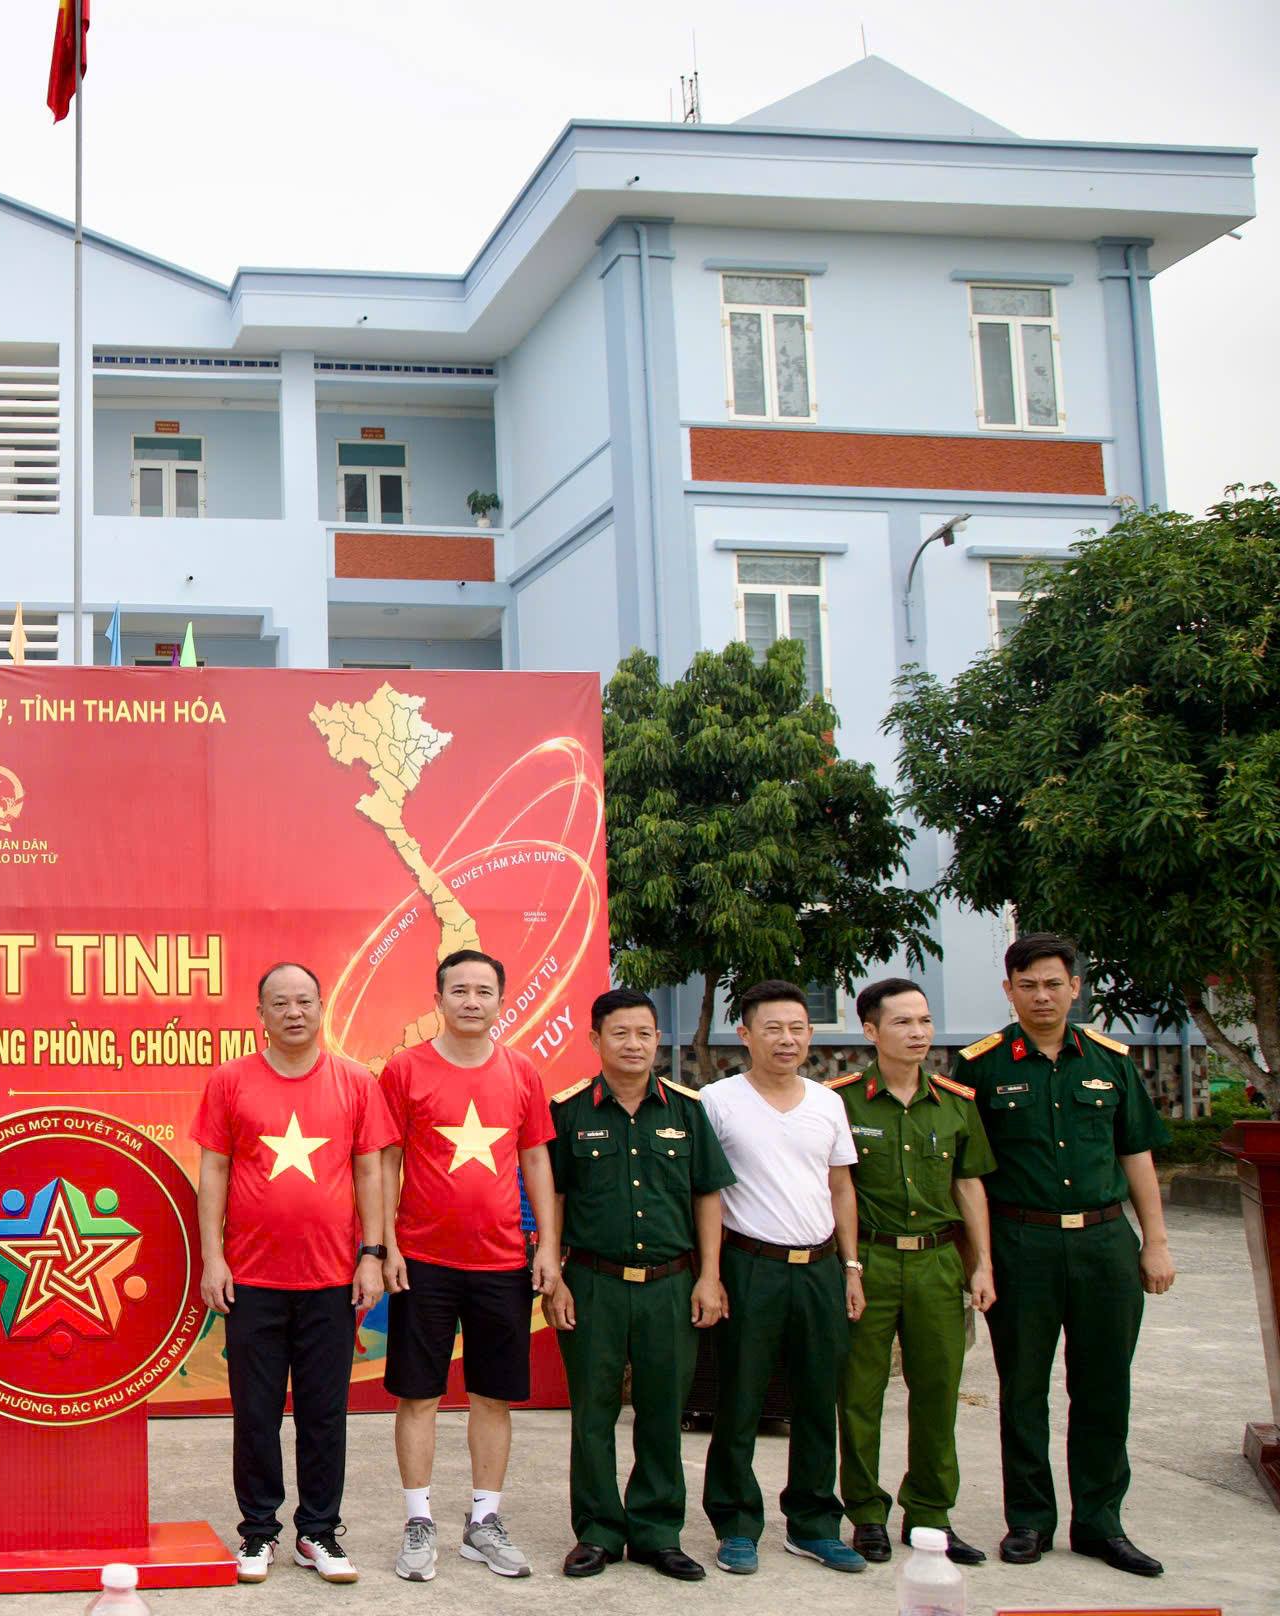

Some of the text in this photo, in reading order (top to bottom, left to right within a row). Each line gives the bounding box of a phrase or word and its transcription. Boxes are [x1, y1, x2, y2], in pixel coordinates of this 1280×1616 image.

[20, 694, 75, 722] TỈNH
[83, 699, 166, 723] THANH
[174, 696, 227, 723] HÓA
[13, 853, 39, 864] DUY
[22, 838, 48, 850] DÂN
[369, 851, 566, 965] CHUNG MỘT QUYẾT TÂM XÂY DỰNG
[55, 933, 222, 996] TINH
[489, 955, 559, 1041] ĐÀO DUY TỪ
[32, 1020, 124, 1071] PHÒNG,
[130, 1017, 213, 1066] CHỐNG
[220, 1028, 258, 1064] MA
[531, 1005, 574, 1058] TÚY
[28, 1117, 61, 1130] MỘT
[64, 1118, 113, 1136] QUYẾT
[116, 1129, 143, 1151] TÂM
[61, 1402, 91, 1416] ĐẶC
[94, 1391, 124, 1409] KHU
[125, 1357, 171, 1396] KHÔNG
[168, 1336, 186, 1357] MA
[181, 1305, 200, 1333] TÚY
